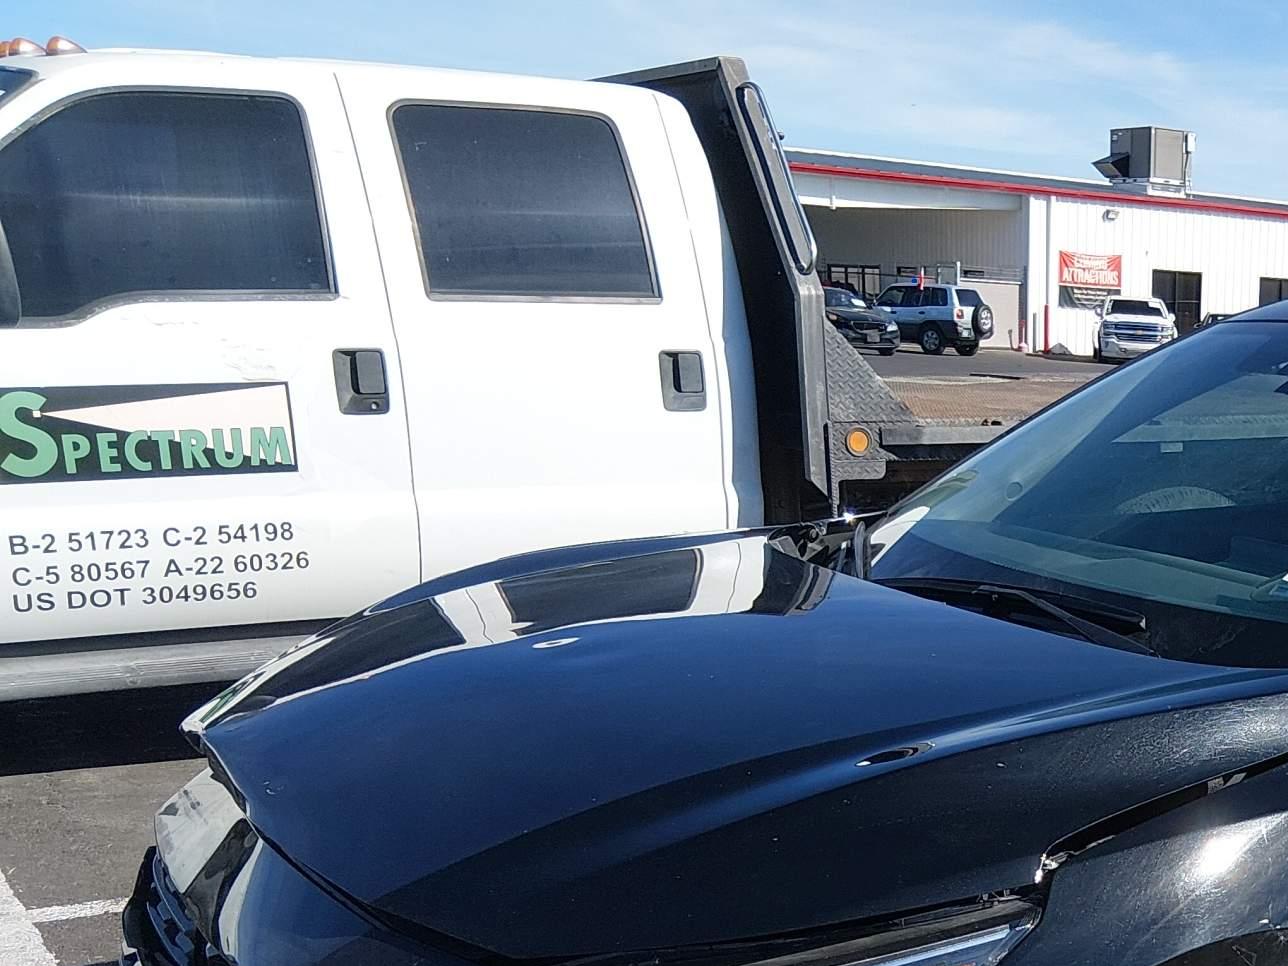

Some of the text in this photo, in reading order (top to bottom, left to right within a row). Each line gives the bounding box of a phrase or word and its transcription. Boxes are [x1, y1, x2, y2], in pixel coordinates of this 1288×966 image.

[1063, 267, 1119, 286] ATTRACTIONS
[0, 390, 293, 478] SPECTRUM
[8, 521, 294, 556] B-2 51723 C-2 54198
[11, 550, 310, 587] C-5 80567 A-22 60326
[12, 581, 258, 613] US DOT 3049656
